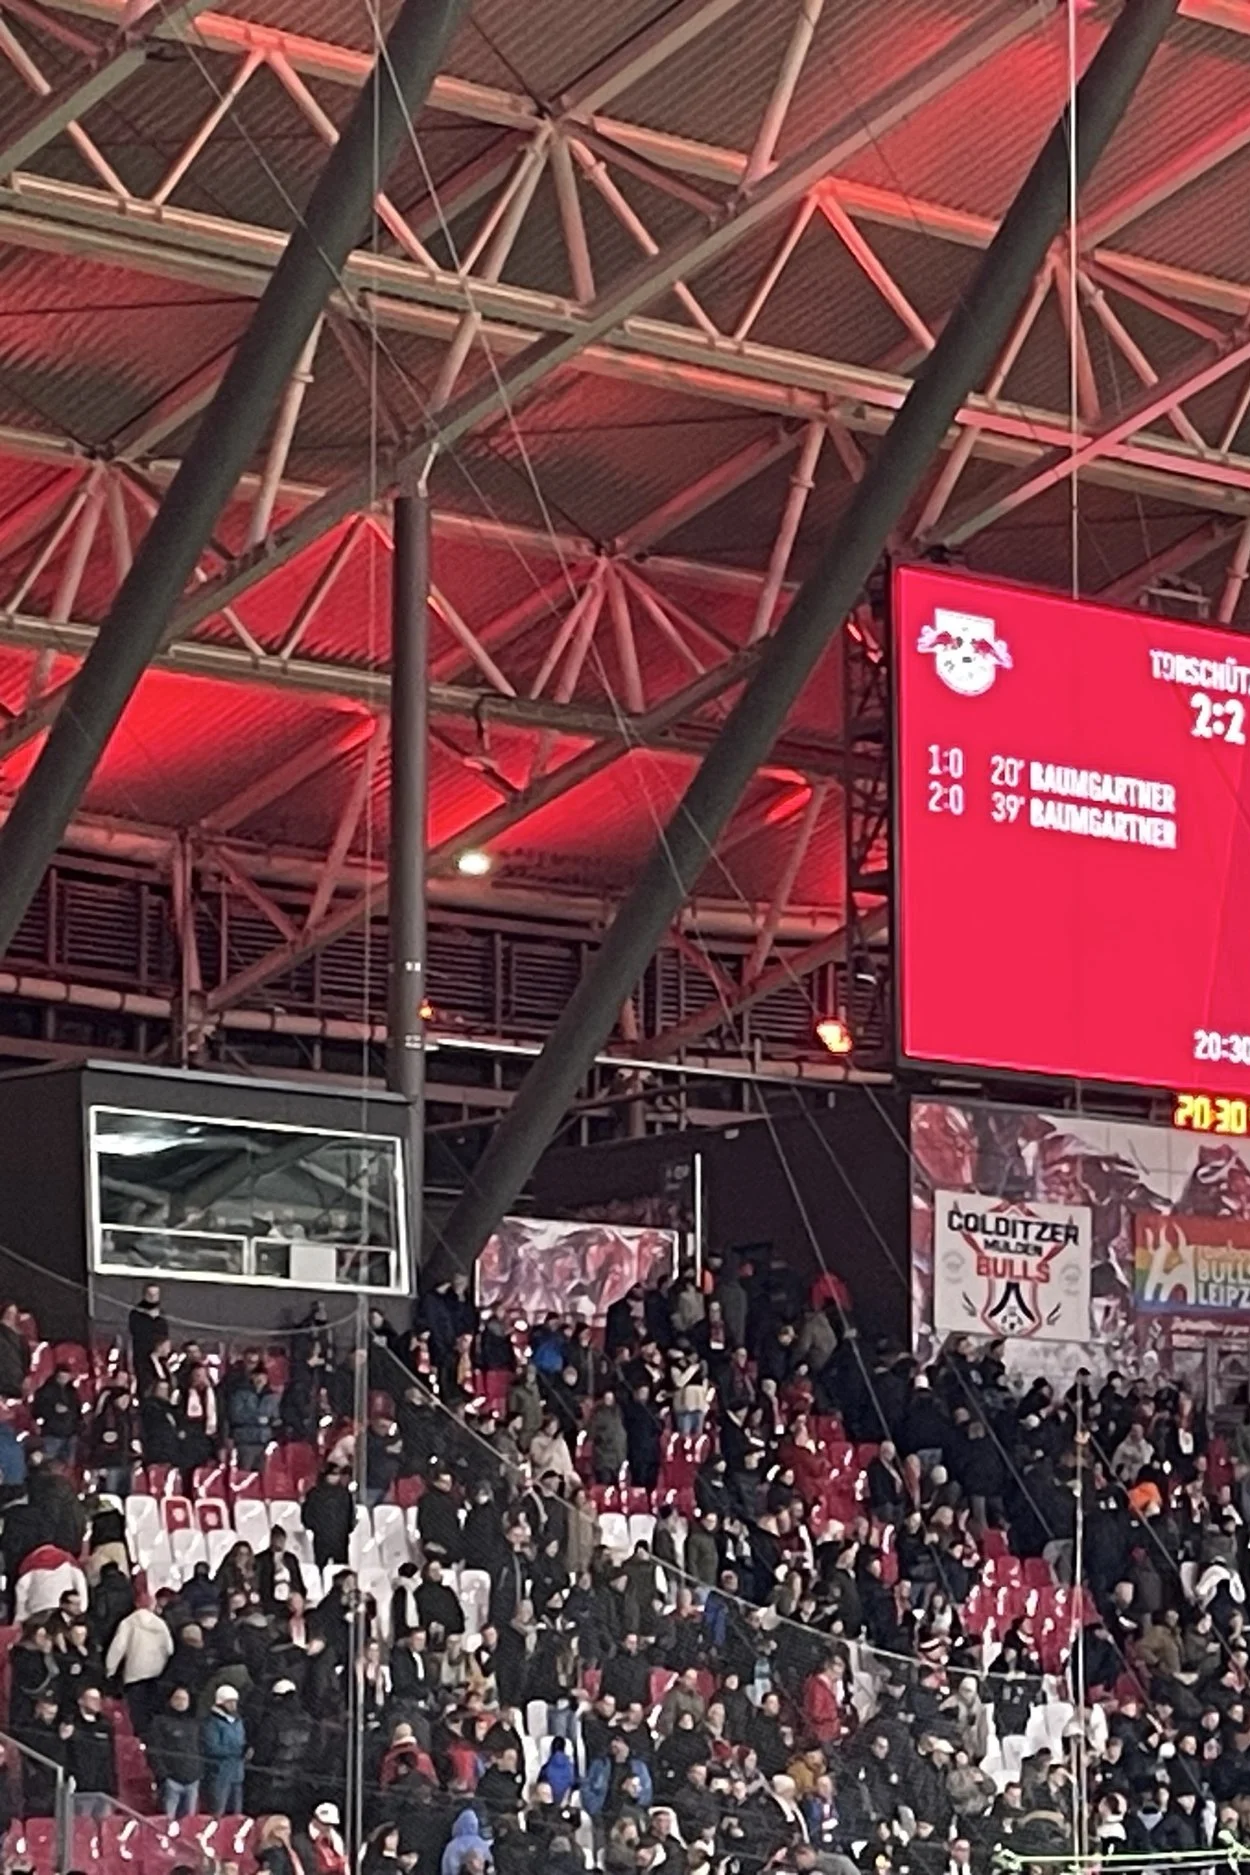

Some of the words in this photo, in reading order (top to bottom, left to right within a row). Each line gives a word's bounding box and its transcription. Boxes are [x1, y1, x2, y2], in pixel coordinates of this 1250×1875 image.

[1190, 692, 1246, 746] 2:2
[928, 743, 964, 779] 1:0
[1030, 760, 1176, 815] BAUMGARTNER
[928, 780, 964, 816] 2:0
[1030, 797, 1177, 850] BAUMGARTNER
[947, 1209, 1080, 1246] COLDITZER
[976, 1255, 1050, 1284] BULLS
